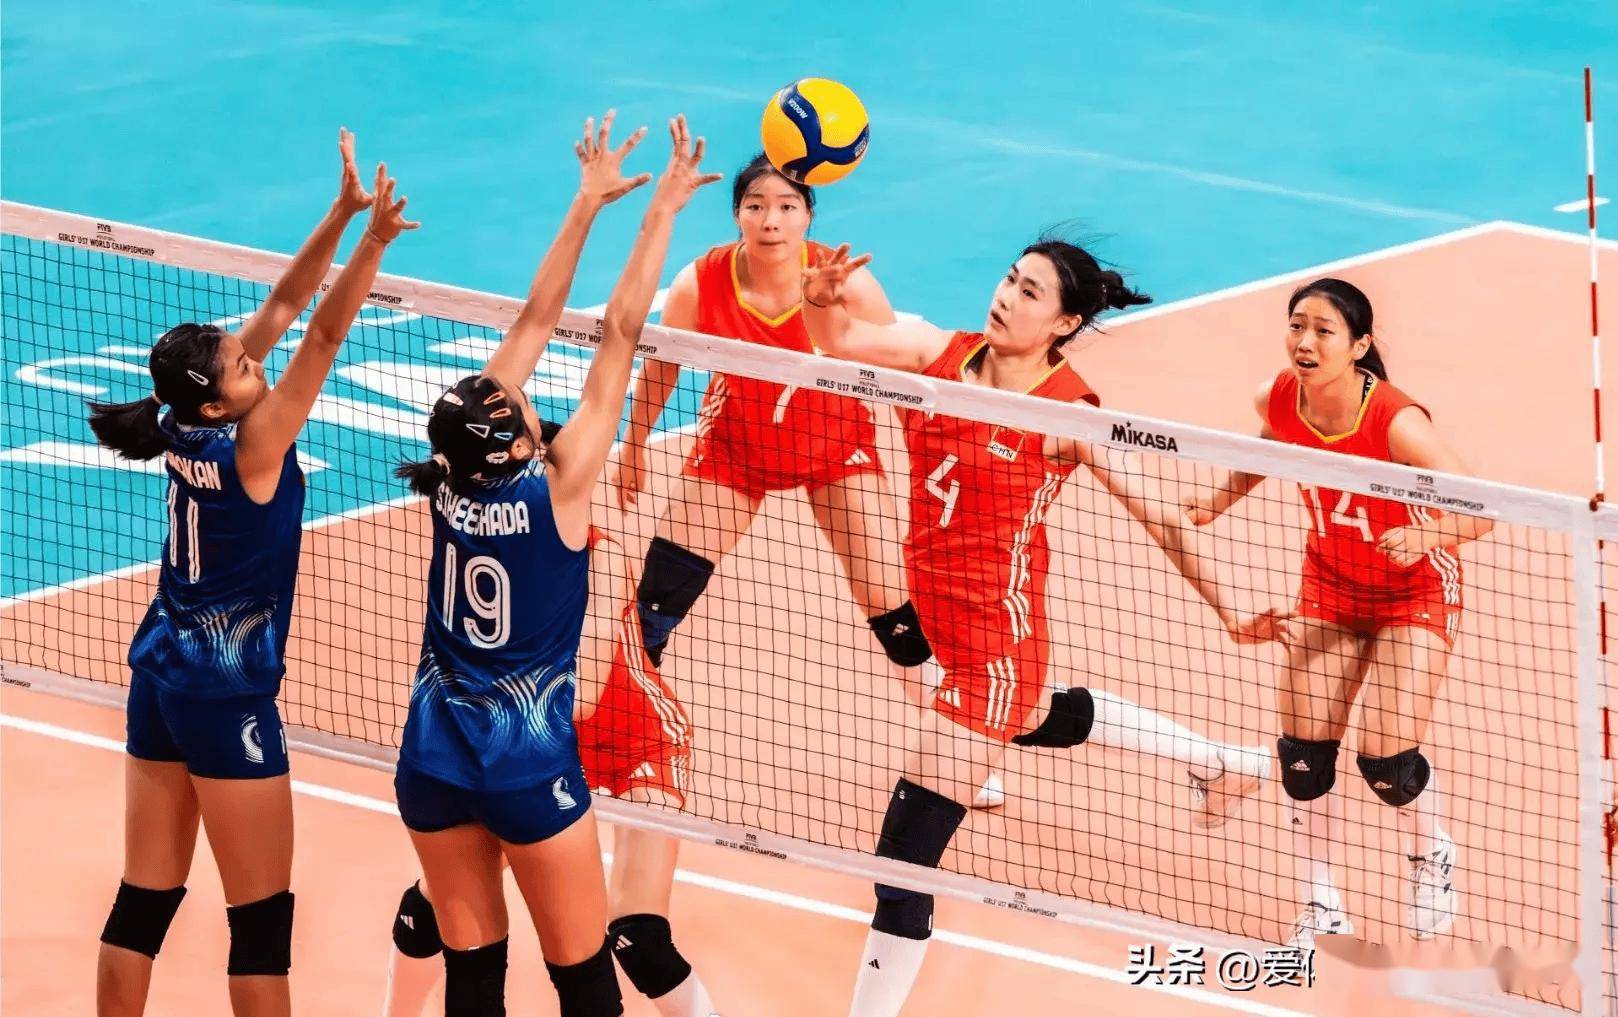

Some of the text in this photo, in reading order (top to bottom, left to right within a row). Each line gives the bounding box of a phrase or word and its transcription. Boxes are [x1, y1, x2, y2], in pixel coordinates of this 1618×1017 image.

[787, 98, 808, 119] V200W
[97, 223, 112, 232] FIVB
[77, 237, 88, 245] U17
[90, 238, 110, 249] WORLD
[112, 242, 155, 256] CHAMPIONSHIP
[575, 332, 587, 341] U17
[859, 369, 875, 379] FIVB
[837, 383, 849, 392] U17
[852, 385, 874, 397] WORLD
[875, 389, 924, 405] CHAMPIONSHIP
[1111, 421, 1179, 453] MIKASA
[990, 442, 1015, 459] CHN
[925, 453, 960, 528] 4
[1392, 487, 1405, 496] U17
[1408, 490, 1431, 501] WORLD
[1433, 494, 1485, 511] CHAMPIONSHIP
[1301, 484, 1375, 543] 14
[168, 481, 200, 584] 11
[443, 542, 511, 649] 19
